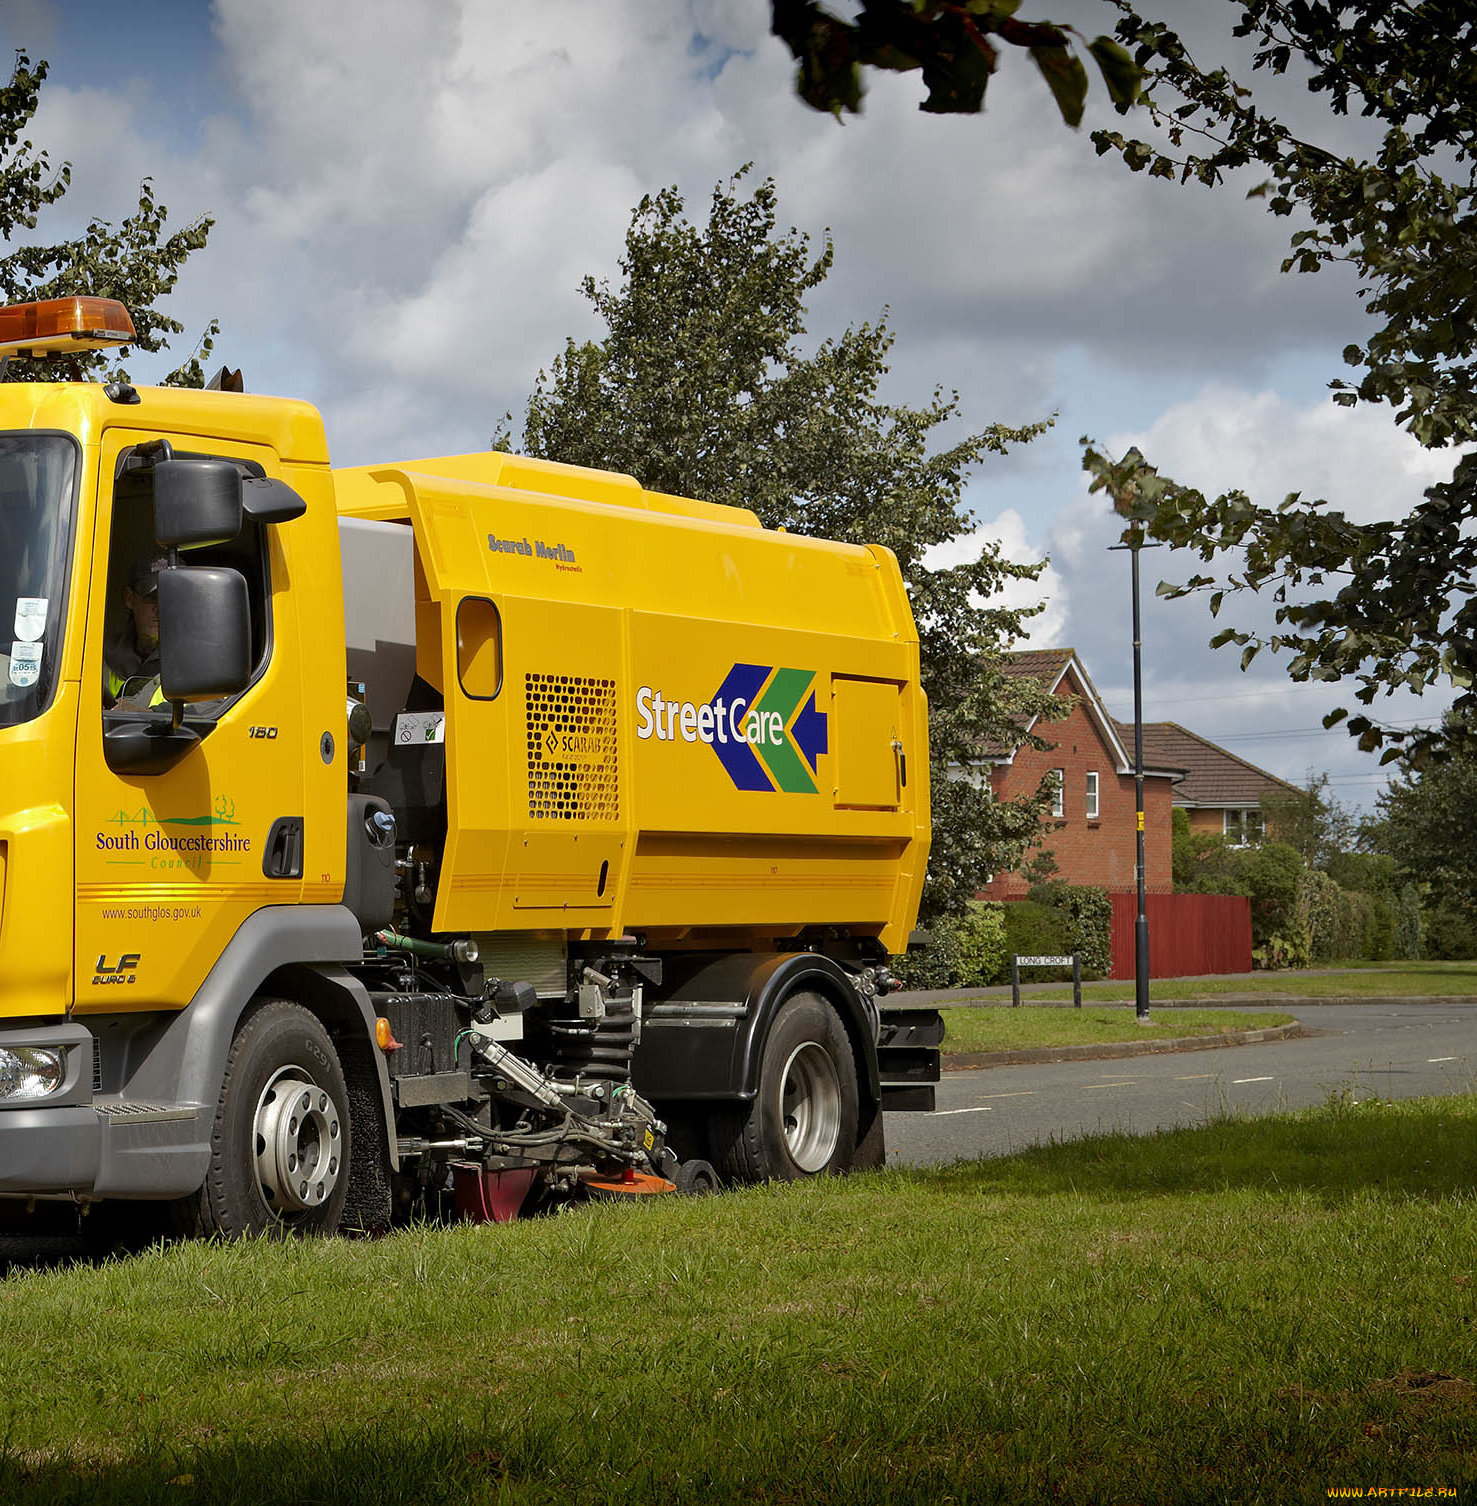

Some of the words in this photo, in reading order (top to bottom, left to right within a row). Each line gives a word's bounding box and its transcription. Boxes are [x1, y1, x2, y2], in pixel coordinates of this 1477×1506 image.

[487, 533, 533, 556] Scarab
[534, 540, 576, 563] Merlin
[635, 685, 784, 746] StreetCare
[249, 725, 279, 740] 180
[561, 736, 602, 754] SCARAB
[96, 830, 140, 851] South
[144, 831, 252, 852] Gloucestershire
[151, 855, 203, 870] Council
[102, 906, 202, 922] www.southglos.gov.uk
[95, 953, 141, 974] LF
[1019, 956, 1042, 965] LONG
[1043, 956, 1071, 965] CROFT
[91, 975, 126, 985] EURO
[127, 974, 137, 984] 6
